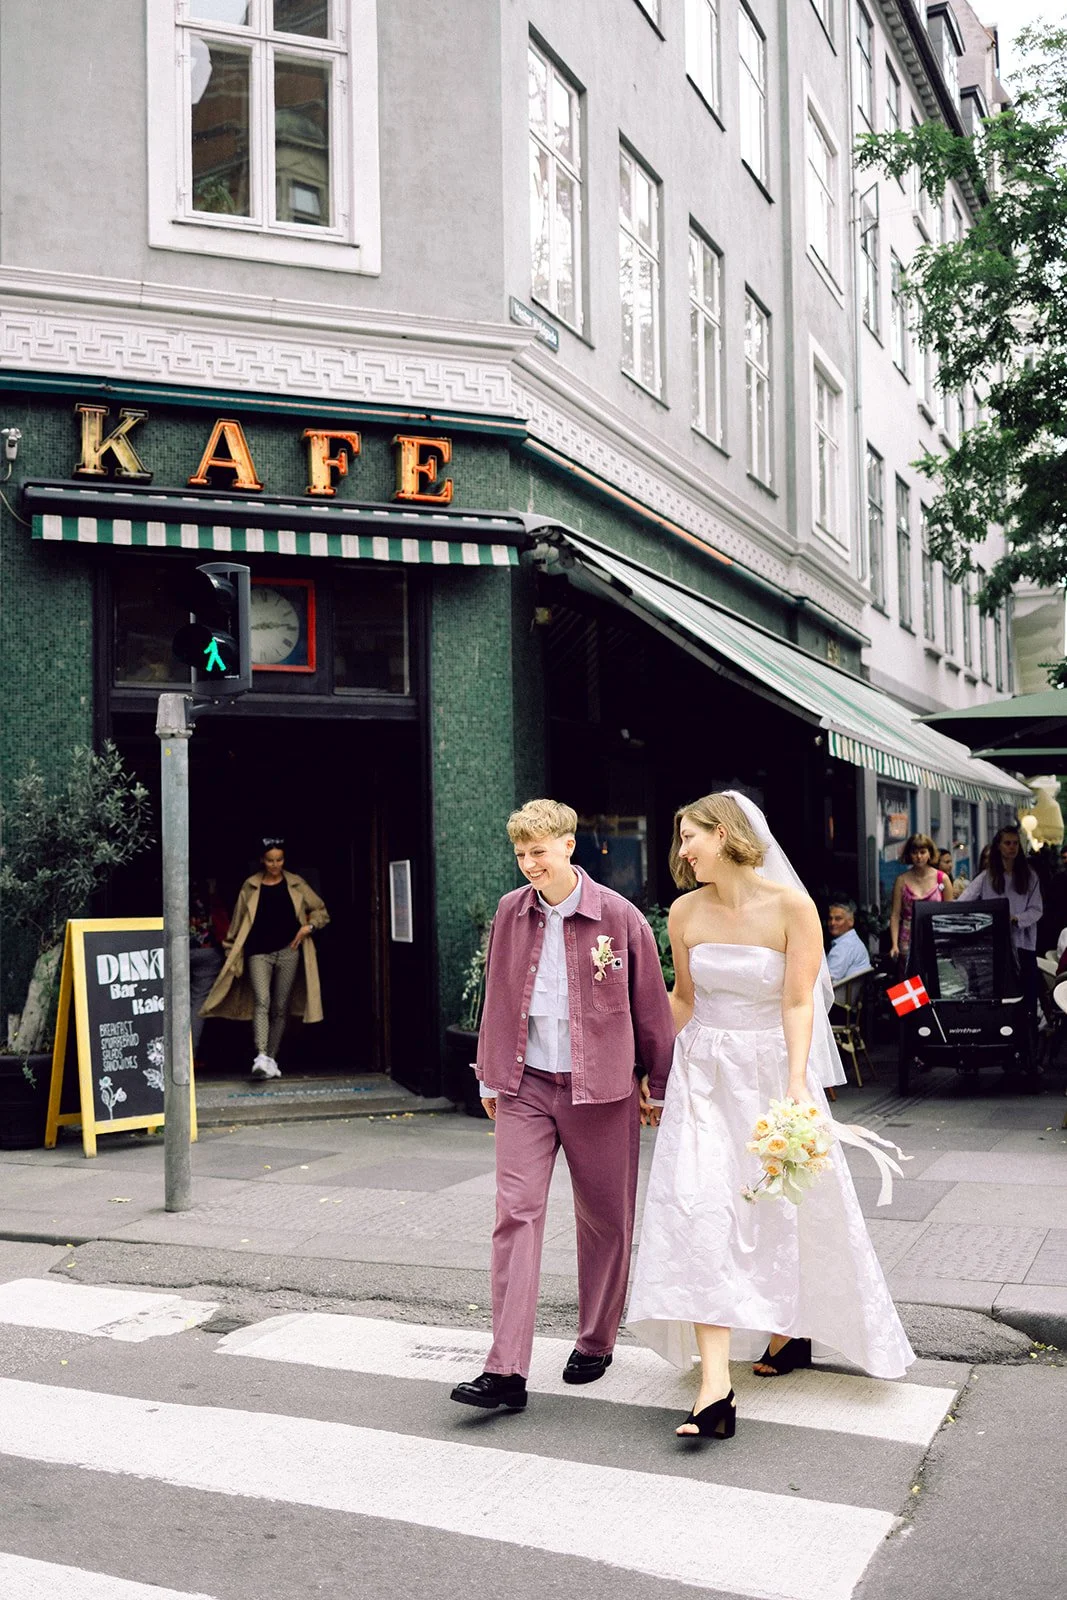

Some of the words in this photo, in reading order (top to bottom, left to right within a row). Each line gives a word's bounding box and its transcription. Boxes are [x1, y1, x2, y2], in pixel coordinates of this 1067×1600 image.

[75, 404, 453, 505] KAFE
[110, 983, 138, 1000] Bar
[102, 1048, 123, 1060] SALADS
